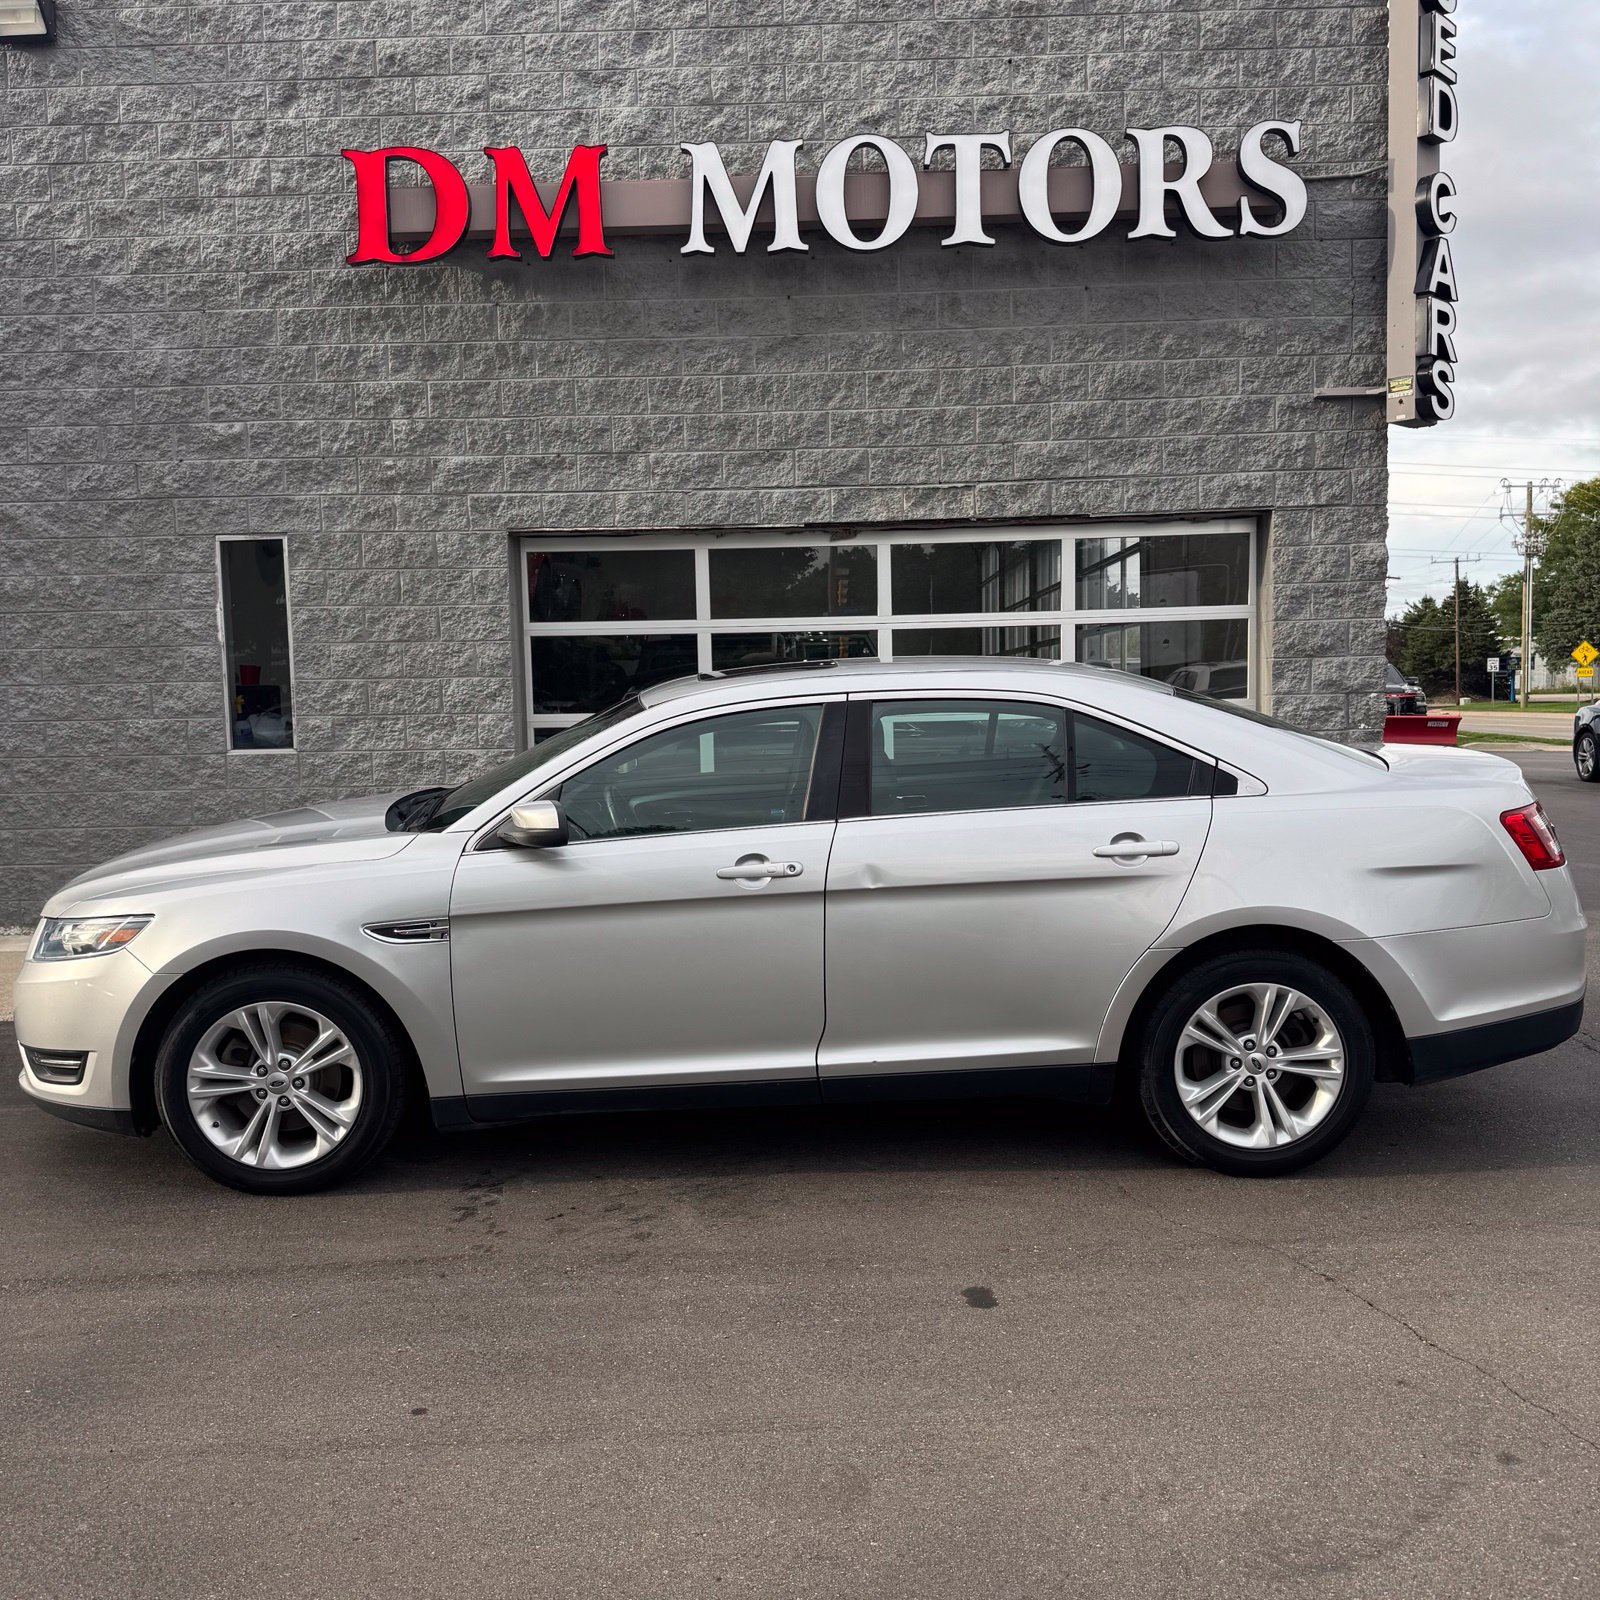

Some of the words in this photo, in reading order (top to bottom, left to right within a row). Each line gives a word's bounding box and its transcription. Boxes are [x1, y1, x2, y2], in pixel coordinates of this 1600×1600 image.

[341, 144, 614, 264] DM
[680, 119, 1309, 255] MOTORS
[1416, 172, 1459, 421] CARS
